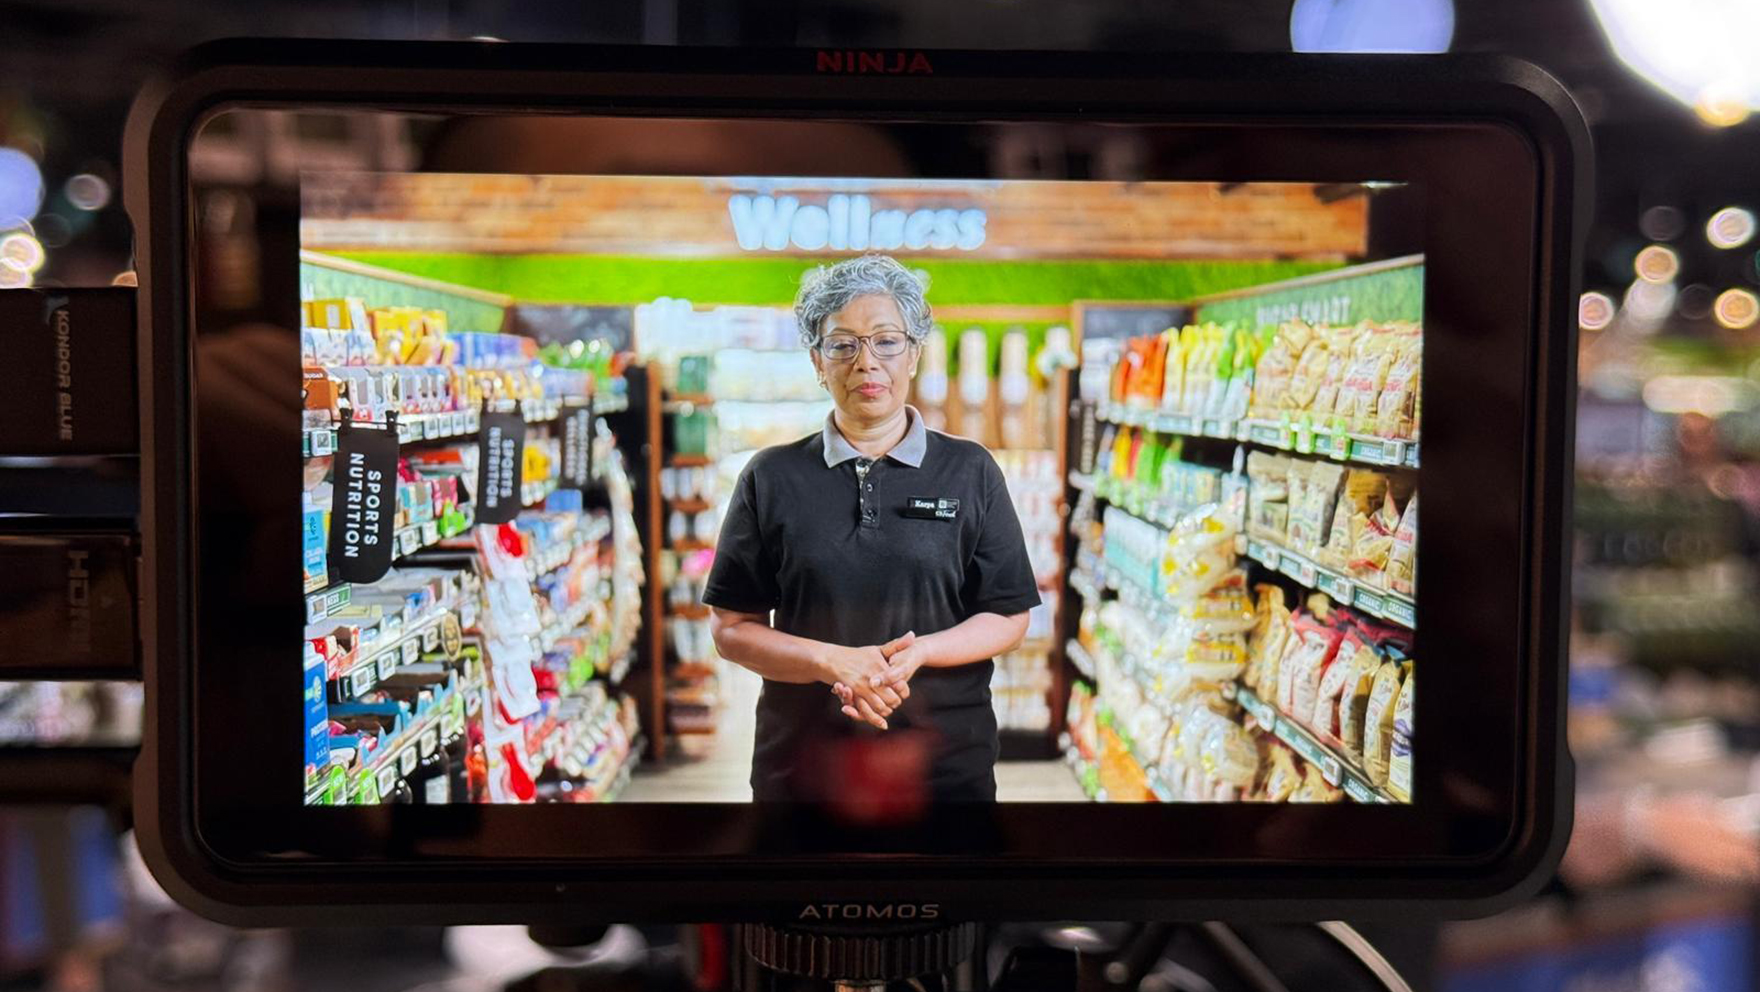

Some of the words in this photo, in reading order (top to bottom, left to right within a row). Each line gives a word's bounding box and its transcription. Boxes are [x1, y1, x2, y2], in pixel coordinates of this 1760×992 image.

[817, 51, 934, 73] NINJA
[728, 194, 987, 251] Wellness
[56, 310, 71, 388] KONDOR
[59, 392, 73, 441] BLUE
[486, 426, 502, 507] NUTRITION
[500, 438, 514, 498] SPORTS
[344, 453, 365, 558] NUTRITION
[363, 470, 382, 546] SPORTS
[68, 551, 91, 652] HDMI
[799, 904, 939, 919] ATOMOS
